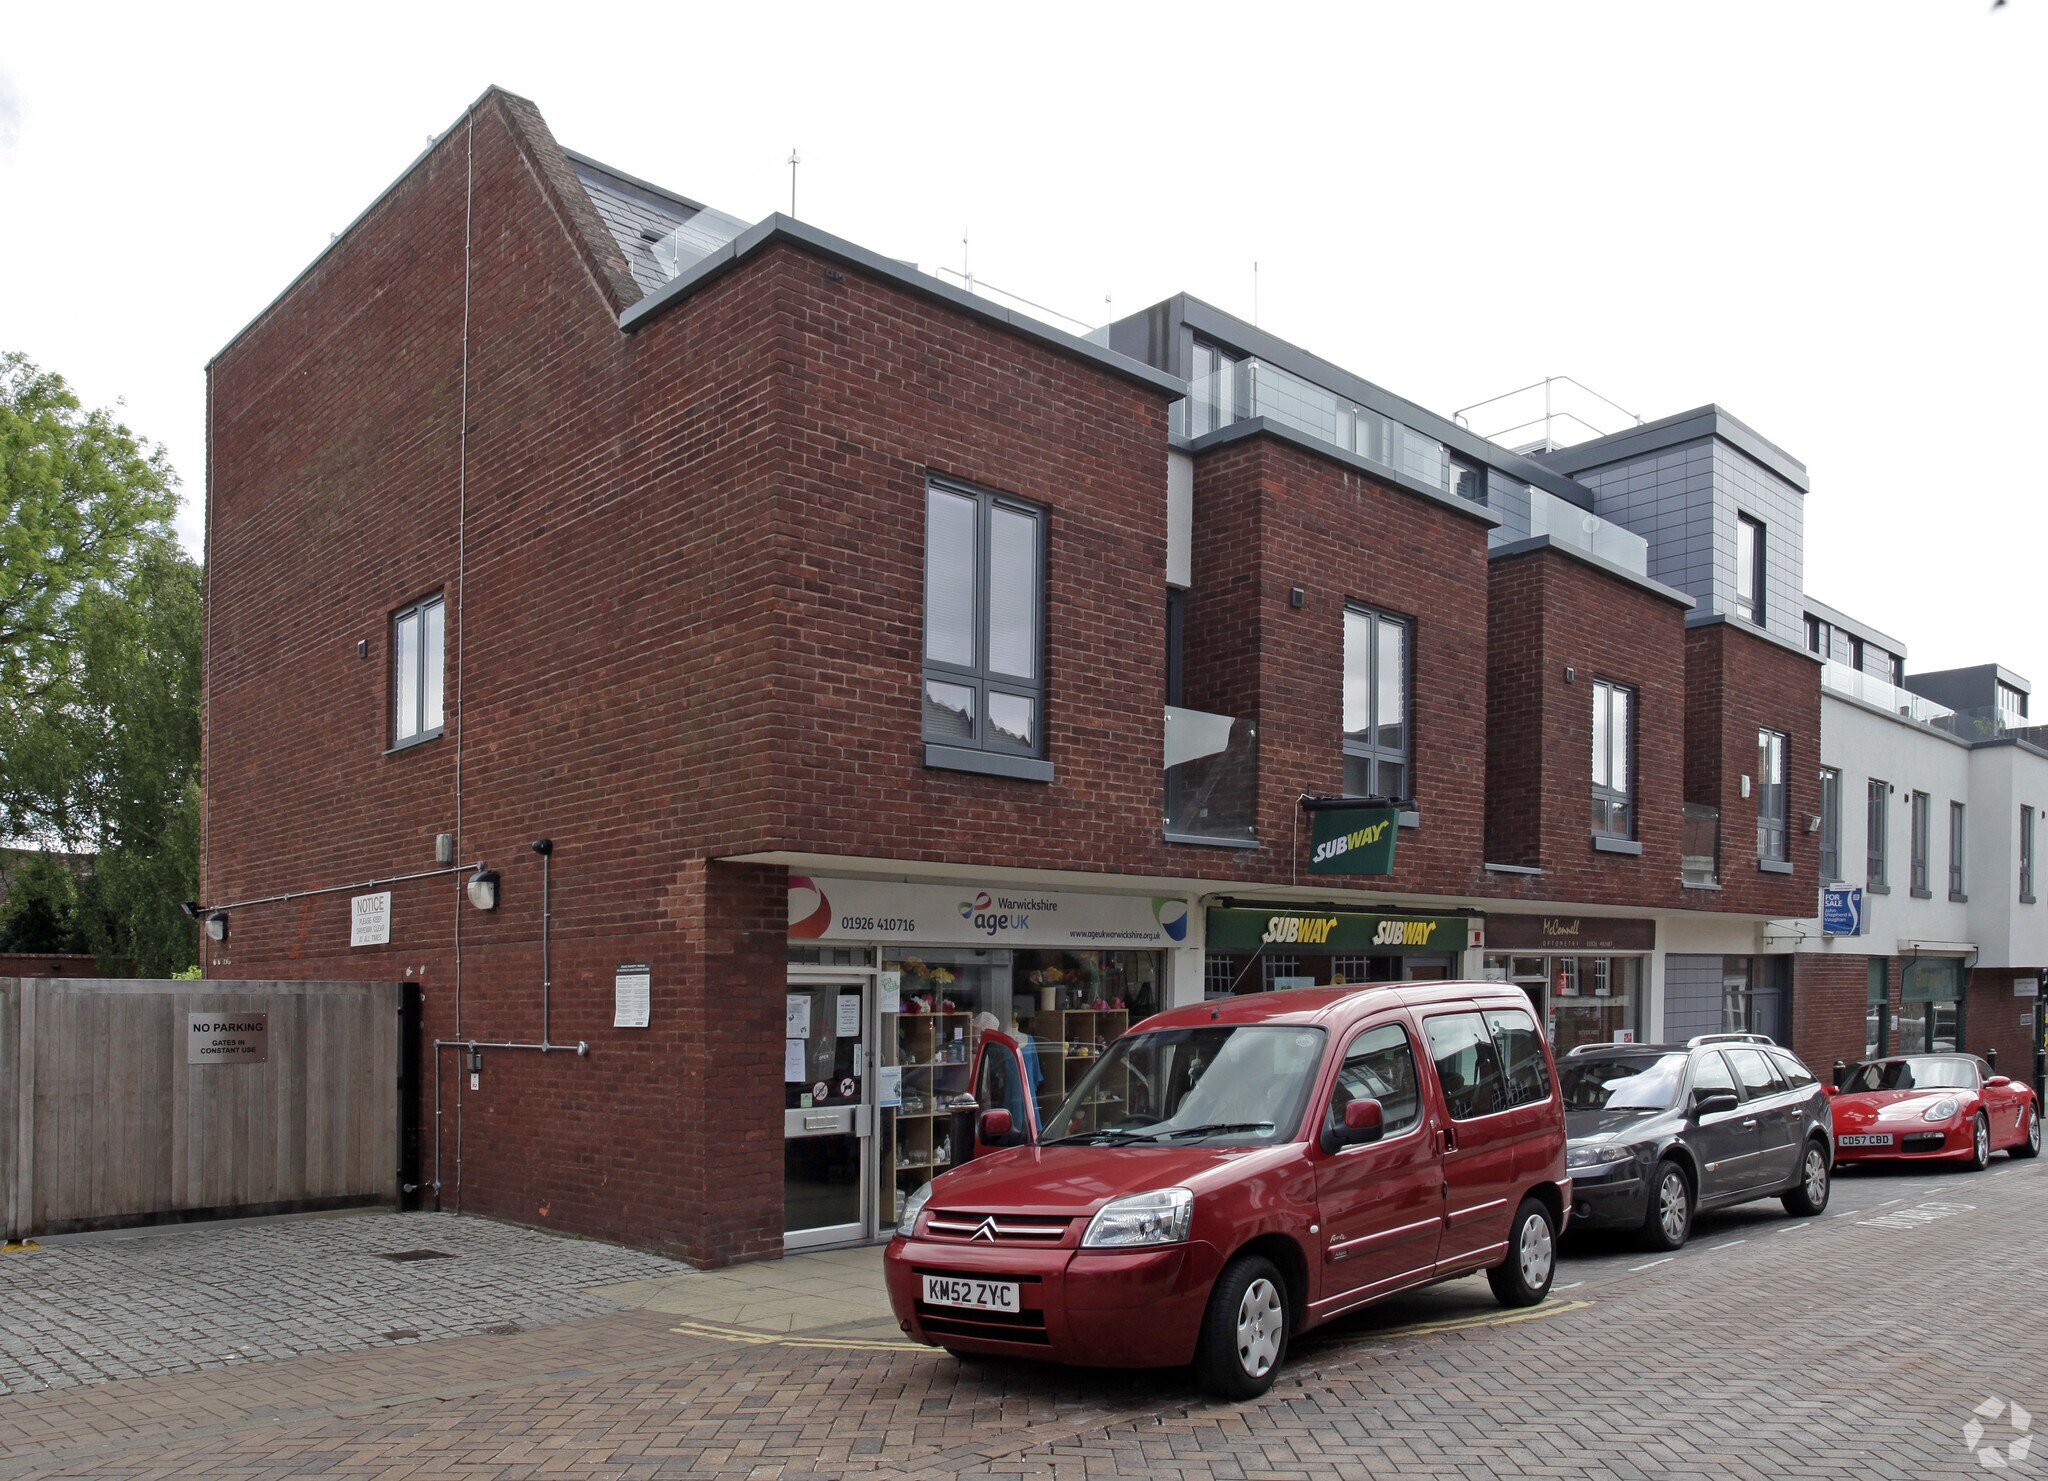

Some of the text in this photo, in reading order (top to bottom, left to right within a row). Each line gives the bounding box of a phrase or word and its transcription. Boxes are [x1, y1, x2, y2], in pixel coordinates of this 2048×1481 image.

[1313, 819, 1389, 863] SUBWAY
[357, 896, 384, 914] NOTICE
[998, 897, 1058, 912] Warwickshire
[359, 917, 372, 925] PLEASE
[373, 924, 385, 932] CLEAR
[841, 917, 915, 932] 01926 410716
[974, 912, 1029, 936] age UK
[1542, 917, 1580, 936] McConnell
[1069, 929, 1161, 942] www.ageukwarwickshire.org.uk
[1261, 916, 1338, 944] SUBWAY
[1372, 920, 1437, 946] SUBWAY
[193, 1023, 264, 1033] NO PARKING
[1842, 1135, 1889, 1145] CD57 CBD
[929, 1279, 1011, 1307] KM52 ZYC
